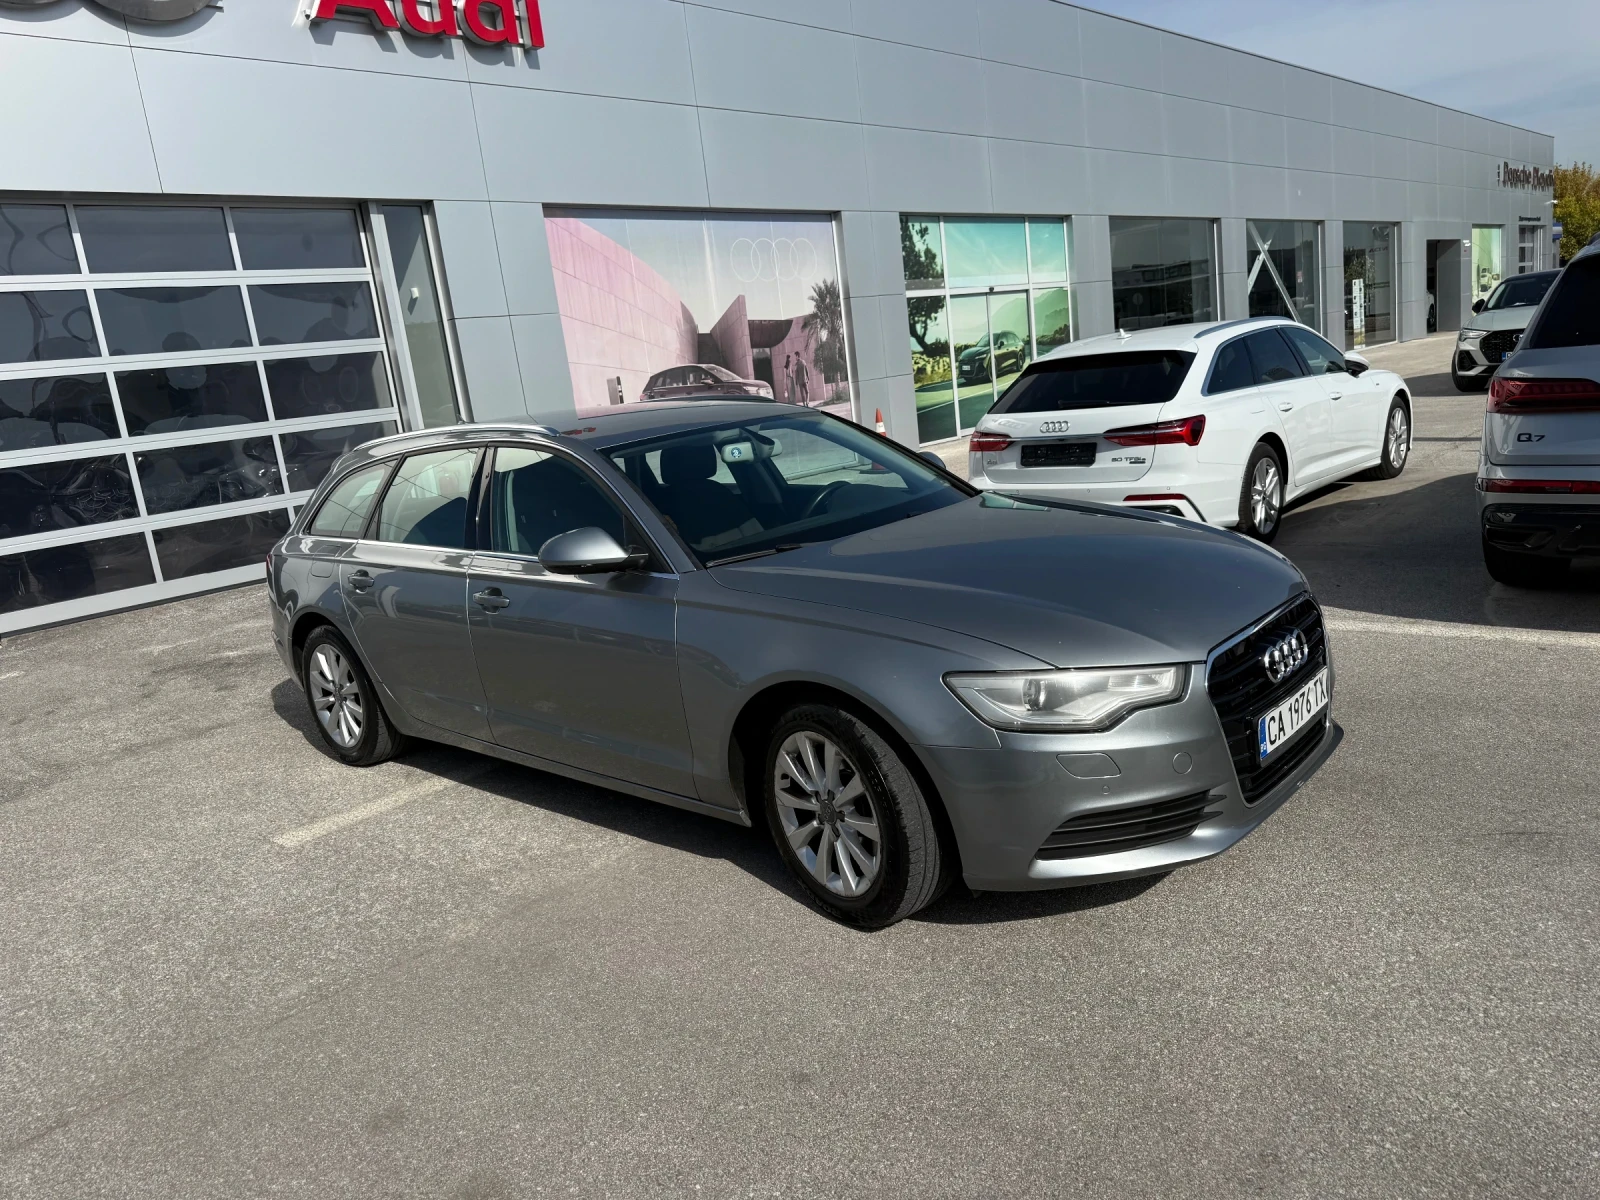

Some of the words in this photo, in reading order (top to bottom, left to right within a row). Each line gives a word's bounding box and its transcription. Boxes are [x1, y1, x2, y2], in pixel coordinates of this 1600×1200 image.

[1503, 161, 1532, 184] Porsche
[1516, 432, 1546, 443] Q7
[1267, 709, 1286, 746] CA
[1288, 686, 1312, 731] 1976
[1313, 673, 1327, 707] TX
